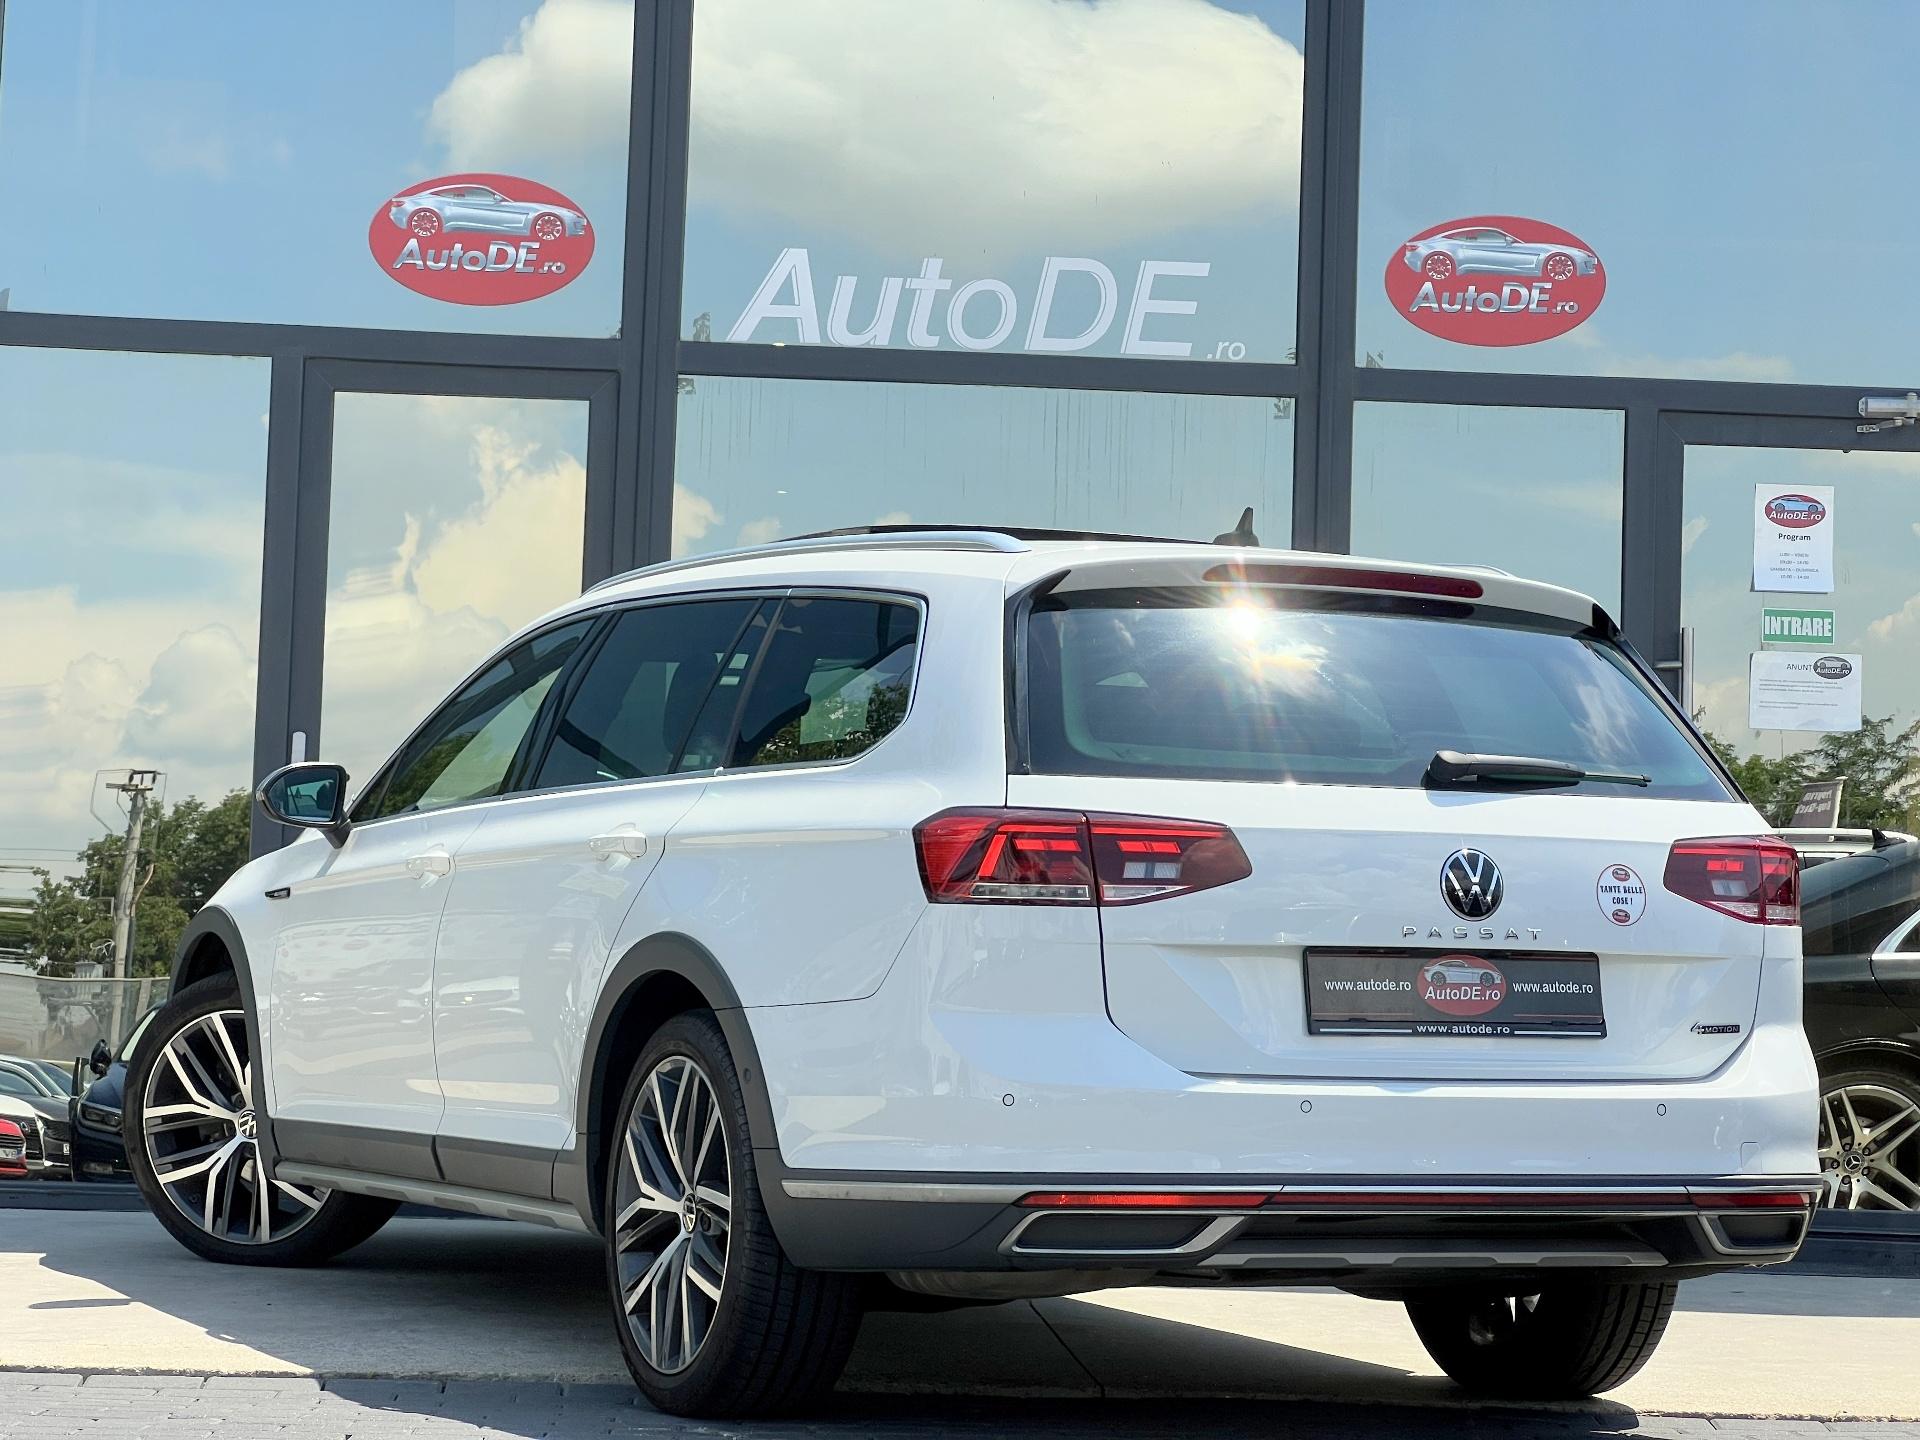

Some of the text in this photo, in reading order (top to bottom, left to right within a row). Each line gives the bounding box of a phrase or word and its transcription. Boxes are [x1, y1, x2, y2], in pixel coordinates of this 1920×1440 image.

[1769, 511, 1822, 521] AutoDE.ro
[1778, 533, 1811, 541] Program
[1764, 616, 1832, 637] INTRARE
[1816, 667, 1850, 675] AutoDE.ro
[1600, 885, 1643, 894] TANTE BELLE
[1612, 896, 1629, 905] COSE
[1402, 926, 1542, 941] PASSAT
[1324, 979, 1594, 1001] www.autode.ro AutoDE.ro www.autode.ro
[1416, 1023, 1510, 1035] www.autode.ro
